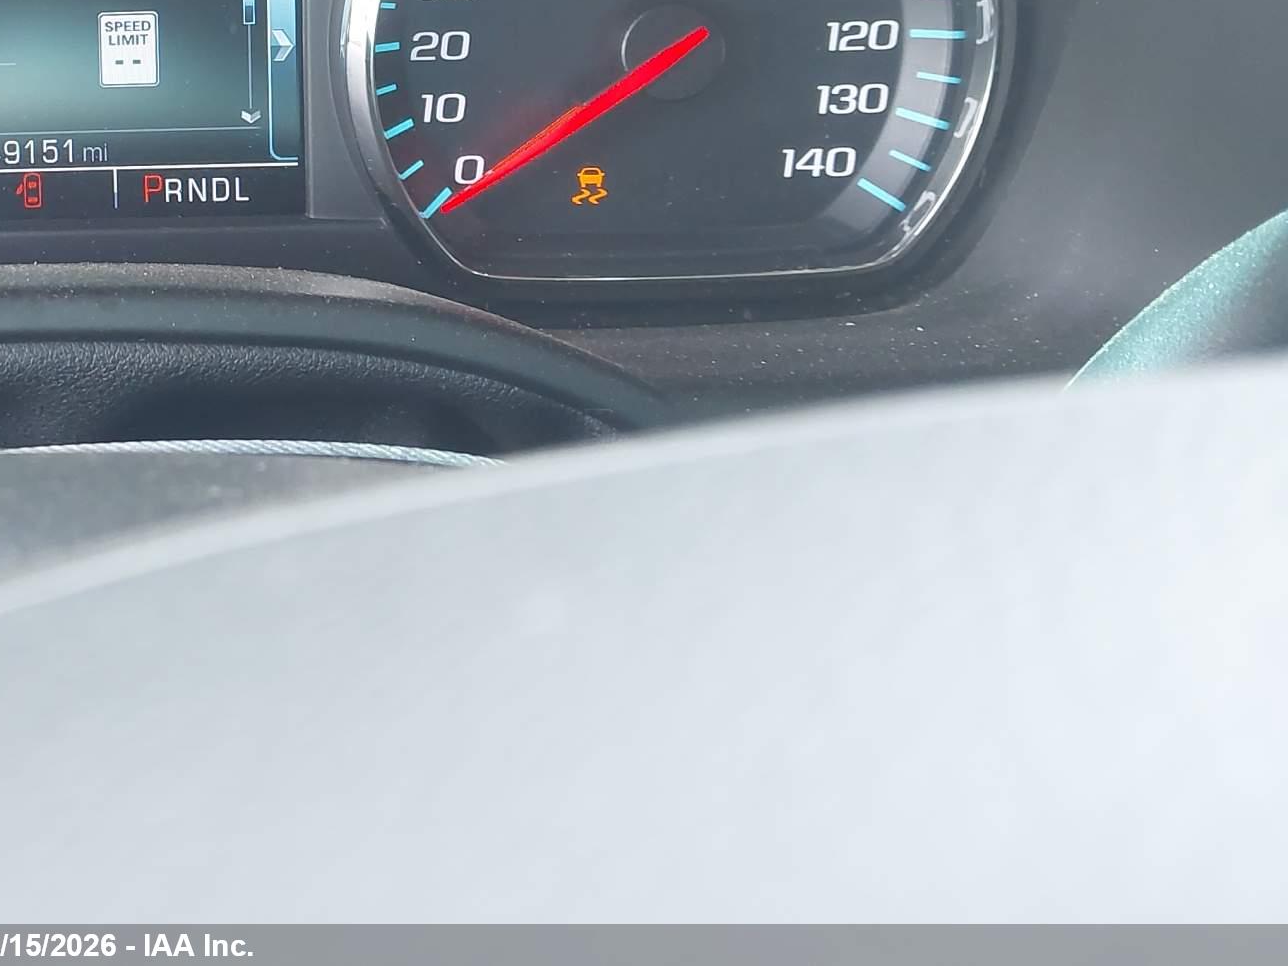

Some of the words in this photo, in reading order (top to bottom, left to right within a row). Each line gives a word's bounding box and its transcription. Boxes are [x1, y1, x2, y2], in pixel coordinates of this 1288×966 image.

[104, 20, 152, 33] SPEED
[108, 33, 149, 46] LIMIT
[826, 19, 900, 52] 120
[410, 31, 470, 61] 20
[421, 93, 466, 123] 10
[817, 83, 888, 114] 130
[83, 143, 109, 162] mi
[782, 147, 857, 178] 140
[454, 155, 485, 185] 0
[144, 174, 250, 204] PRNDL
